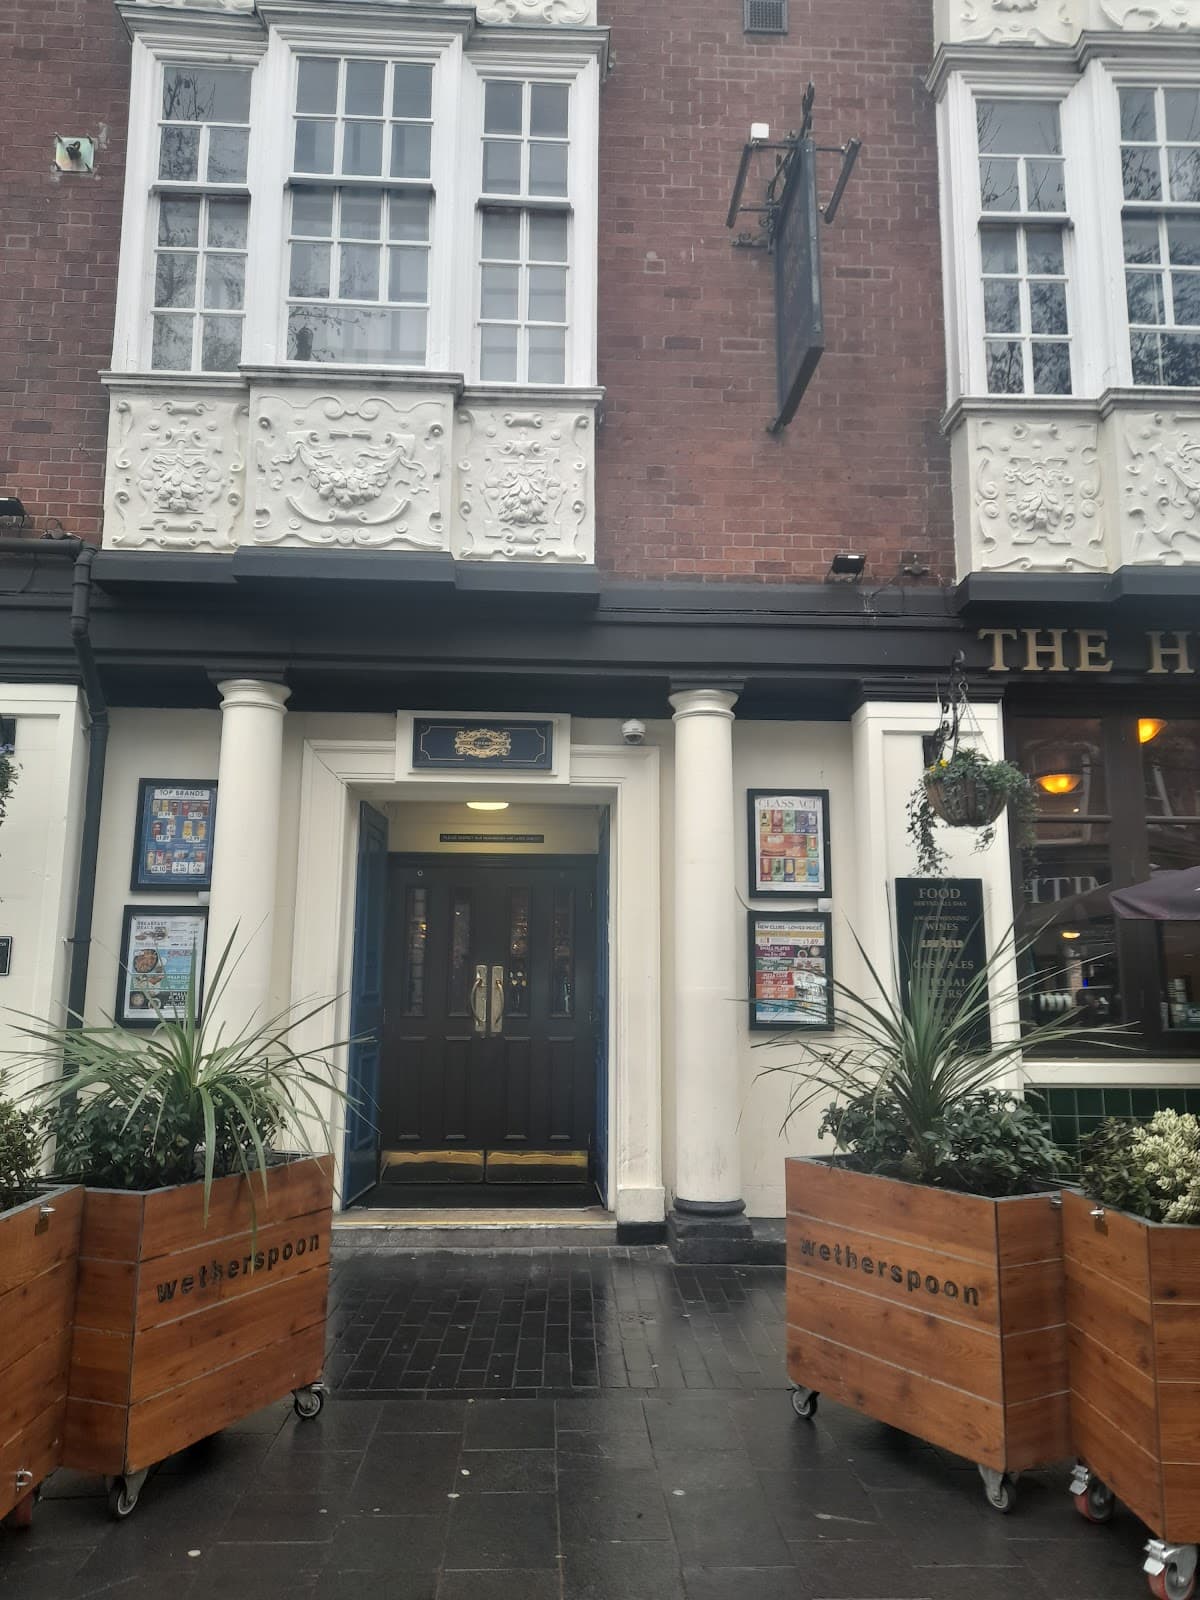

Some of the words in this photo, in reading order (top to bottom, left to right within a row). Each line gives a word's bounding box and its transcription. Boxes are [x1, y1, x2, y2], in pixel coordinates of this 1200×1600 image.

[977, 628, 1114, 672] THE
[1145, 630, 1200, 674] H
[798, 799, 817, 809] ACT
[919, 887, 961, 899] FOOD
[927, 922, 959, 931] WINES
[156, 1233, 320, 1304] wetherspoon
[799, 1237, 980, 1307] wetherspoon
